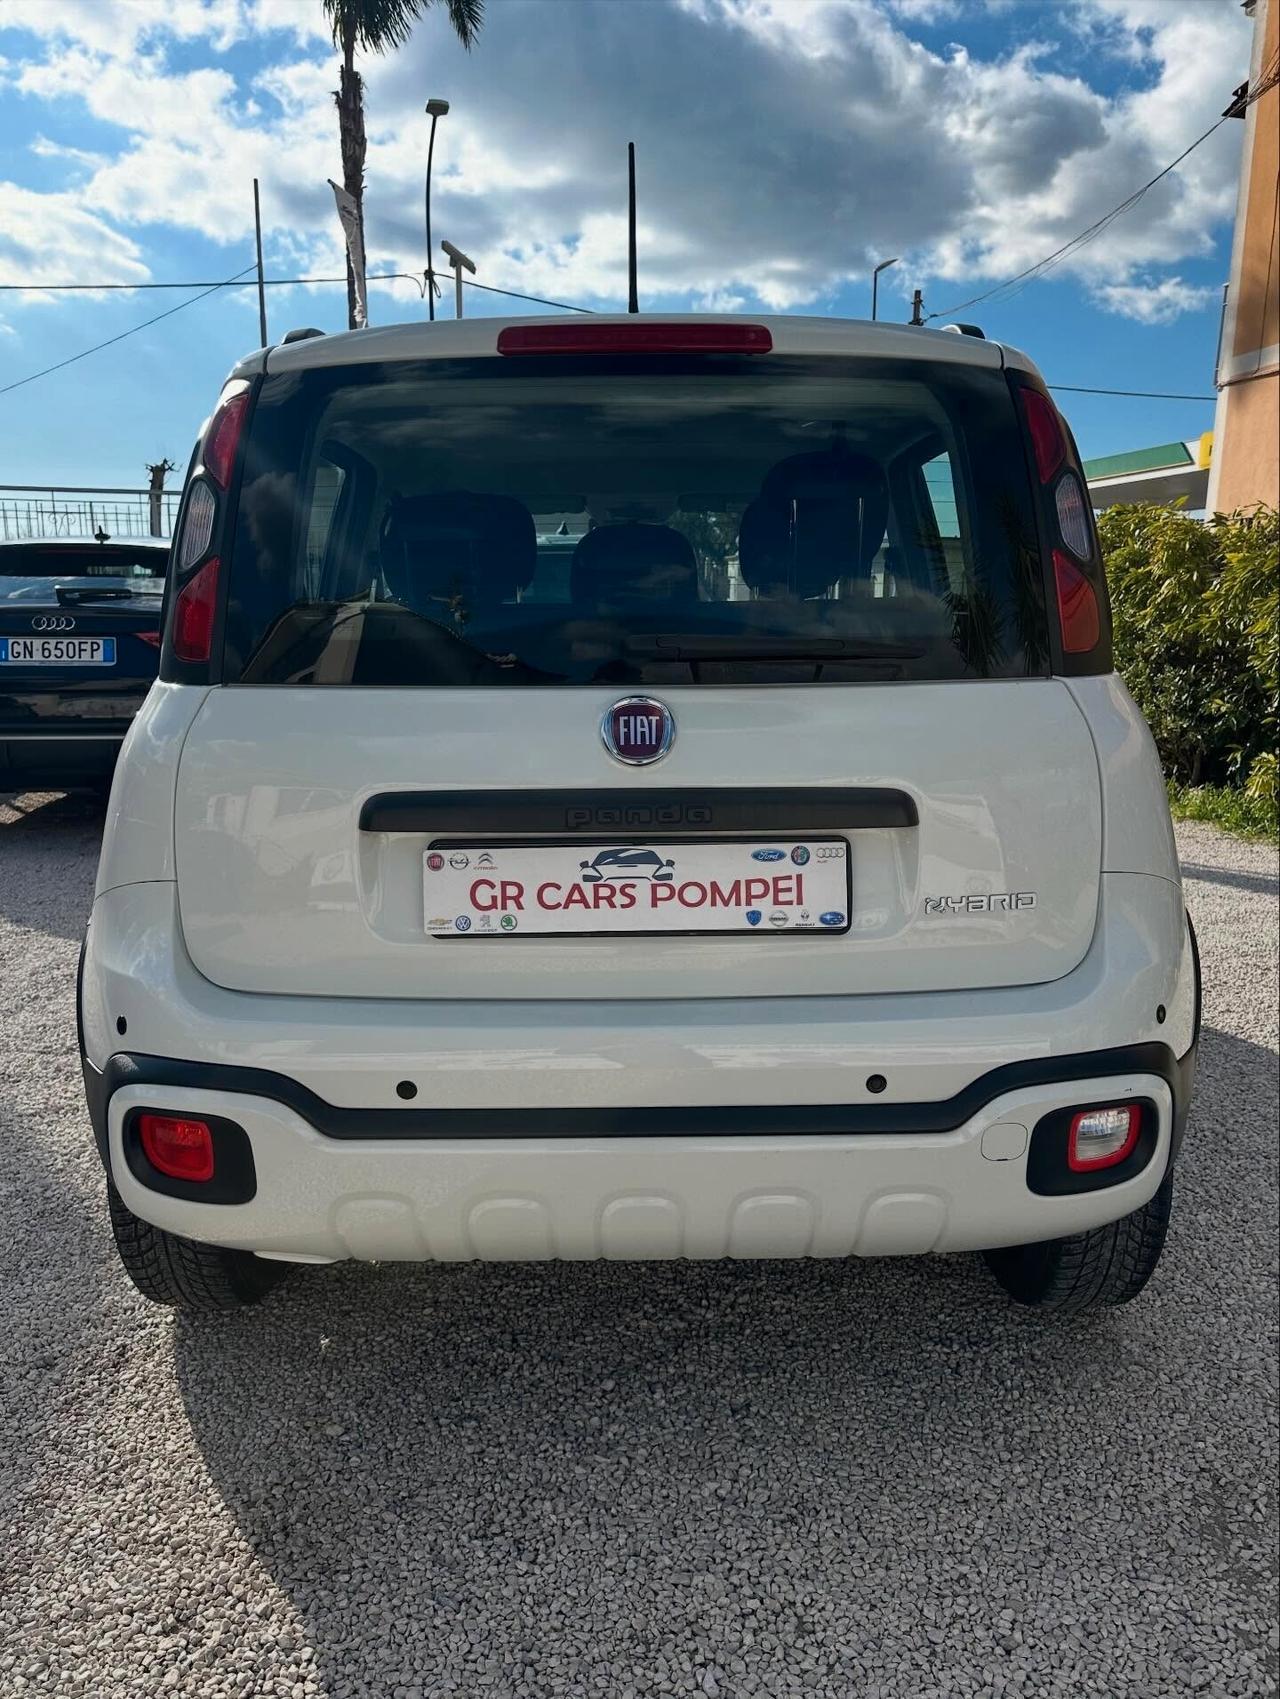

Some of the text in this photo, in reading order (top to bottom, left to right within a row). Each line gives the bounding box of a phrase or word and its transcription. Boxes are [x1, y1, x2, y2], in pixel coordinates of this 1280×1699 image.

[11, 641, 101, 659] GN 650FP
[619, 716, 660, 745] FIAT
[565, 805, 713, 829] panda
[469, 873, 804, 911] GR CARS POMPEI
[925, 892, 1037, 914] HYBRID
